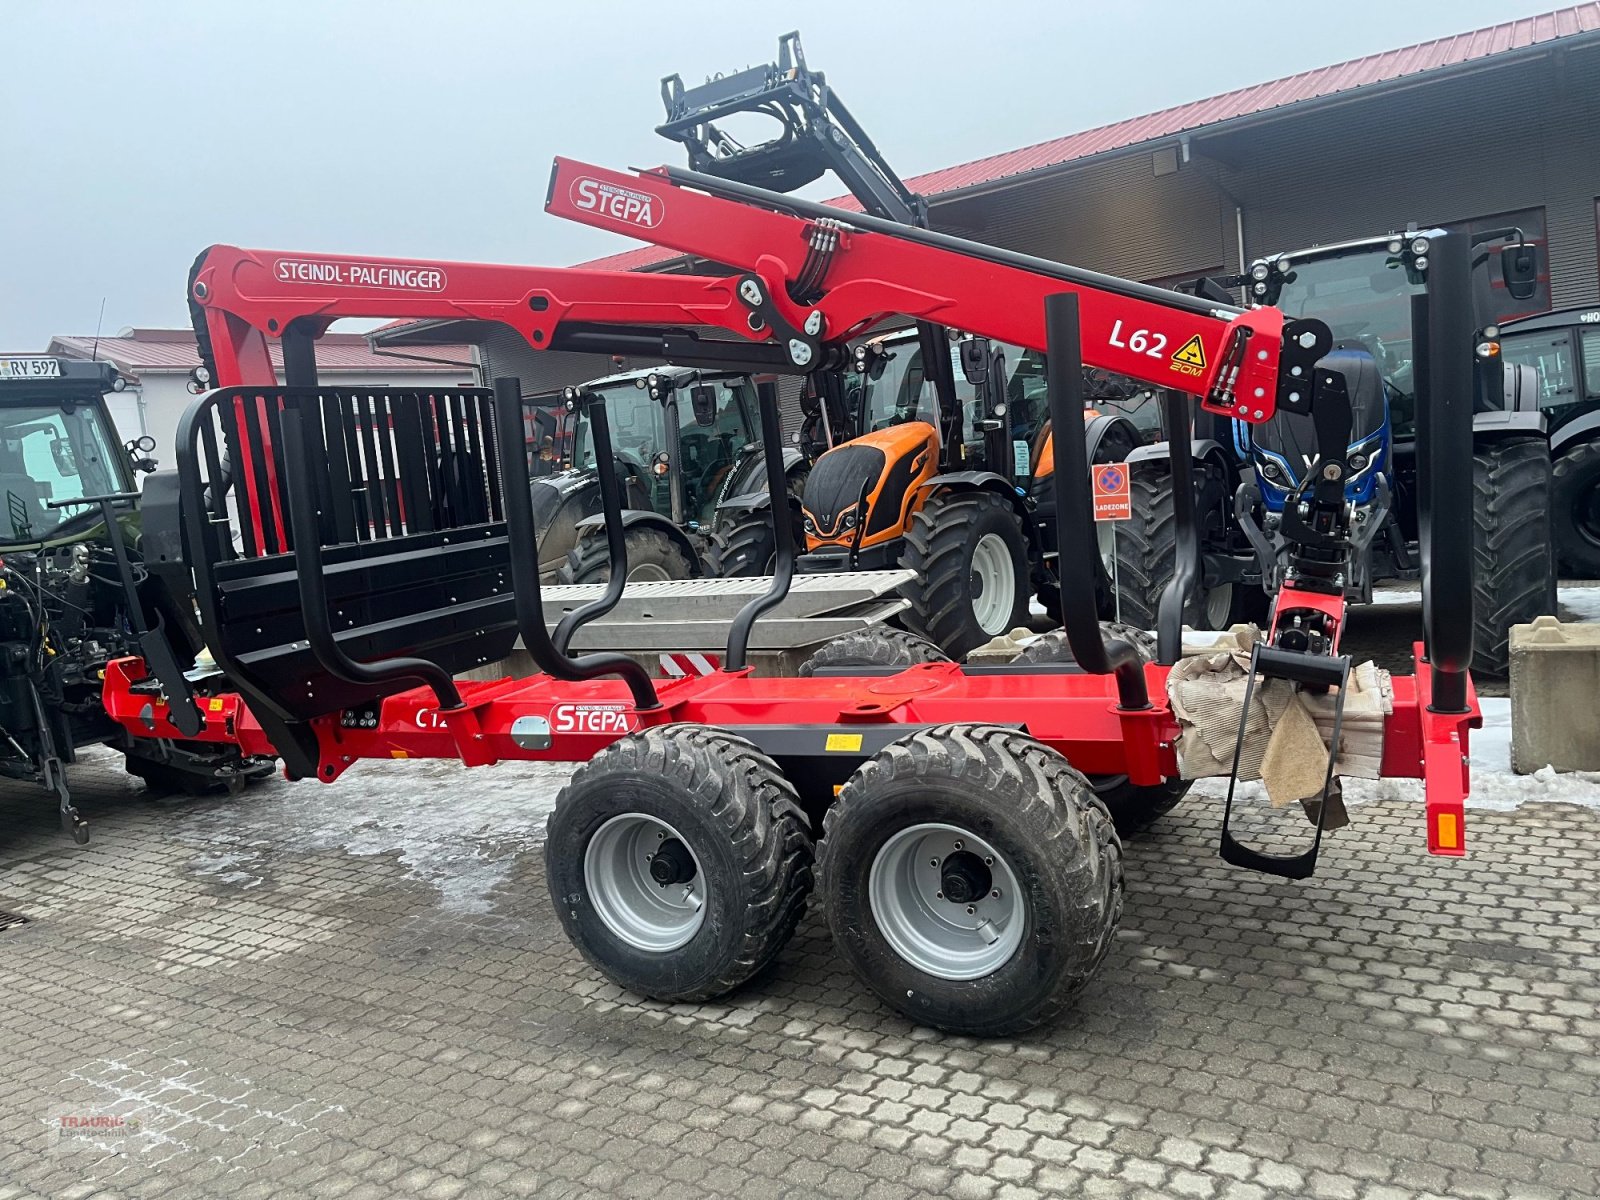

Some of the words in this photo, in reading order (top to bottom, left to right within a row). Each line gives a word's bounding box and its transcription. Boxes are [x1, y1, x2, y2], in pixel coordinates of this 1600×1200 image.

[577, 180, 652, 226] STEPA
[279, 262, 441, 288] STEINDL-PALFINGER
[1109, 319, 1167, 359] L62
[10, 361, 28, 375] RY
[32, 361, 57, 375] 597
[1169, 361, 1203, 377] 20M
[1096, 503, 1129, 511] LADEZONE
[557, 705, 629, 731] STEPA
